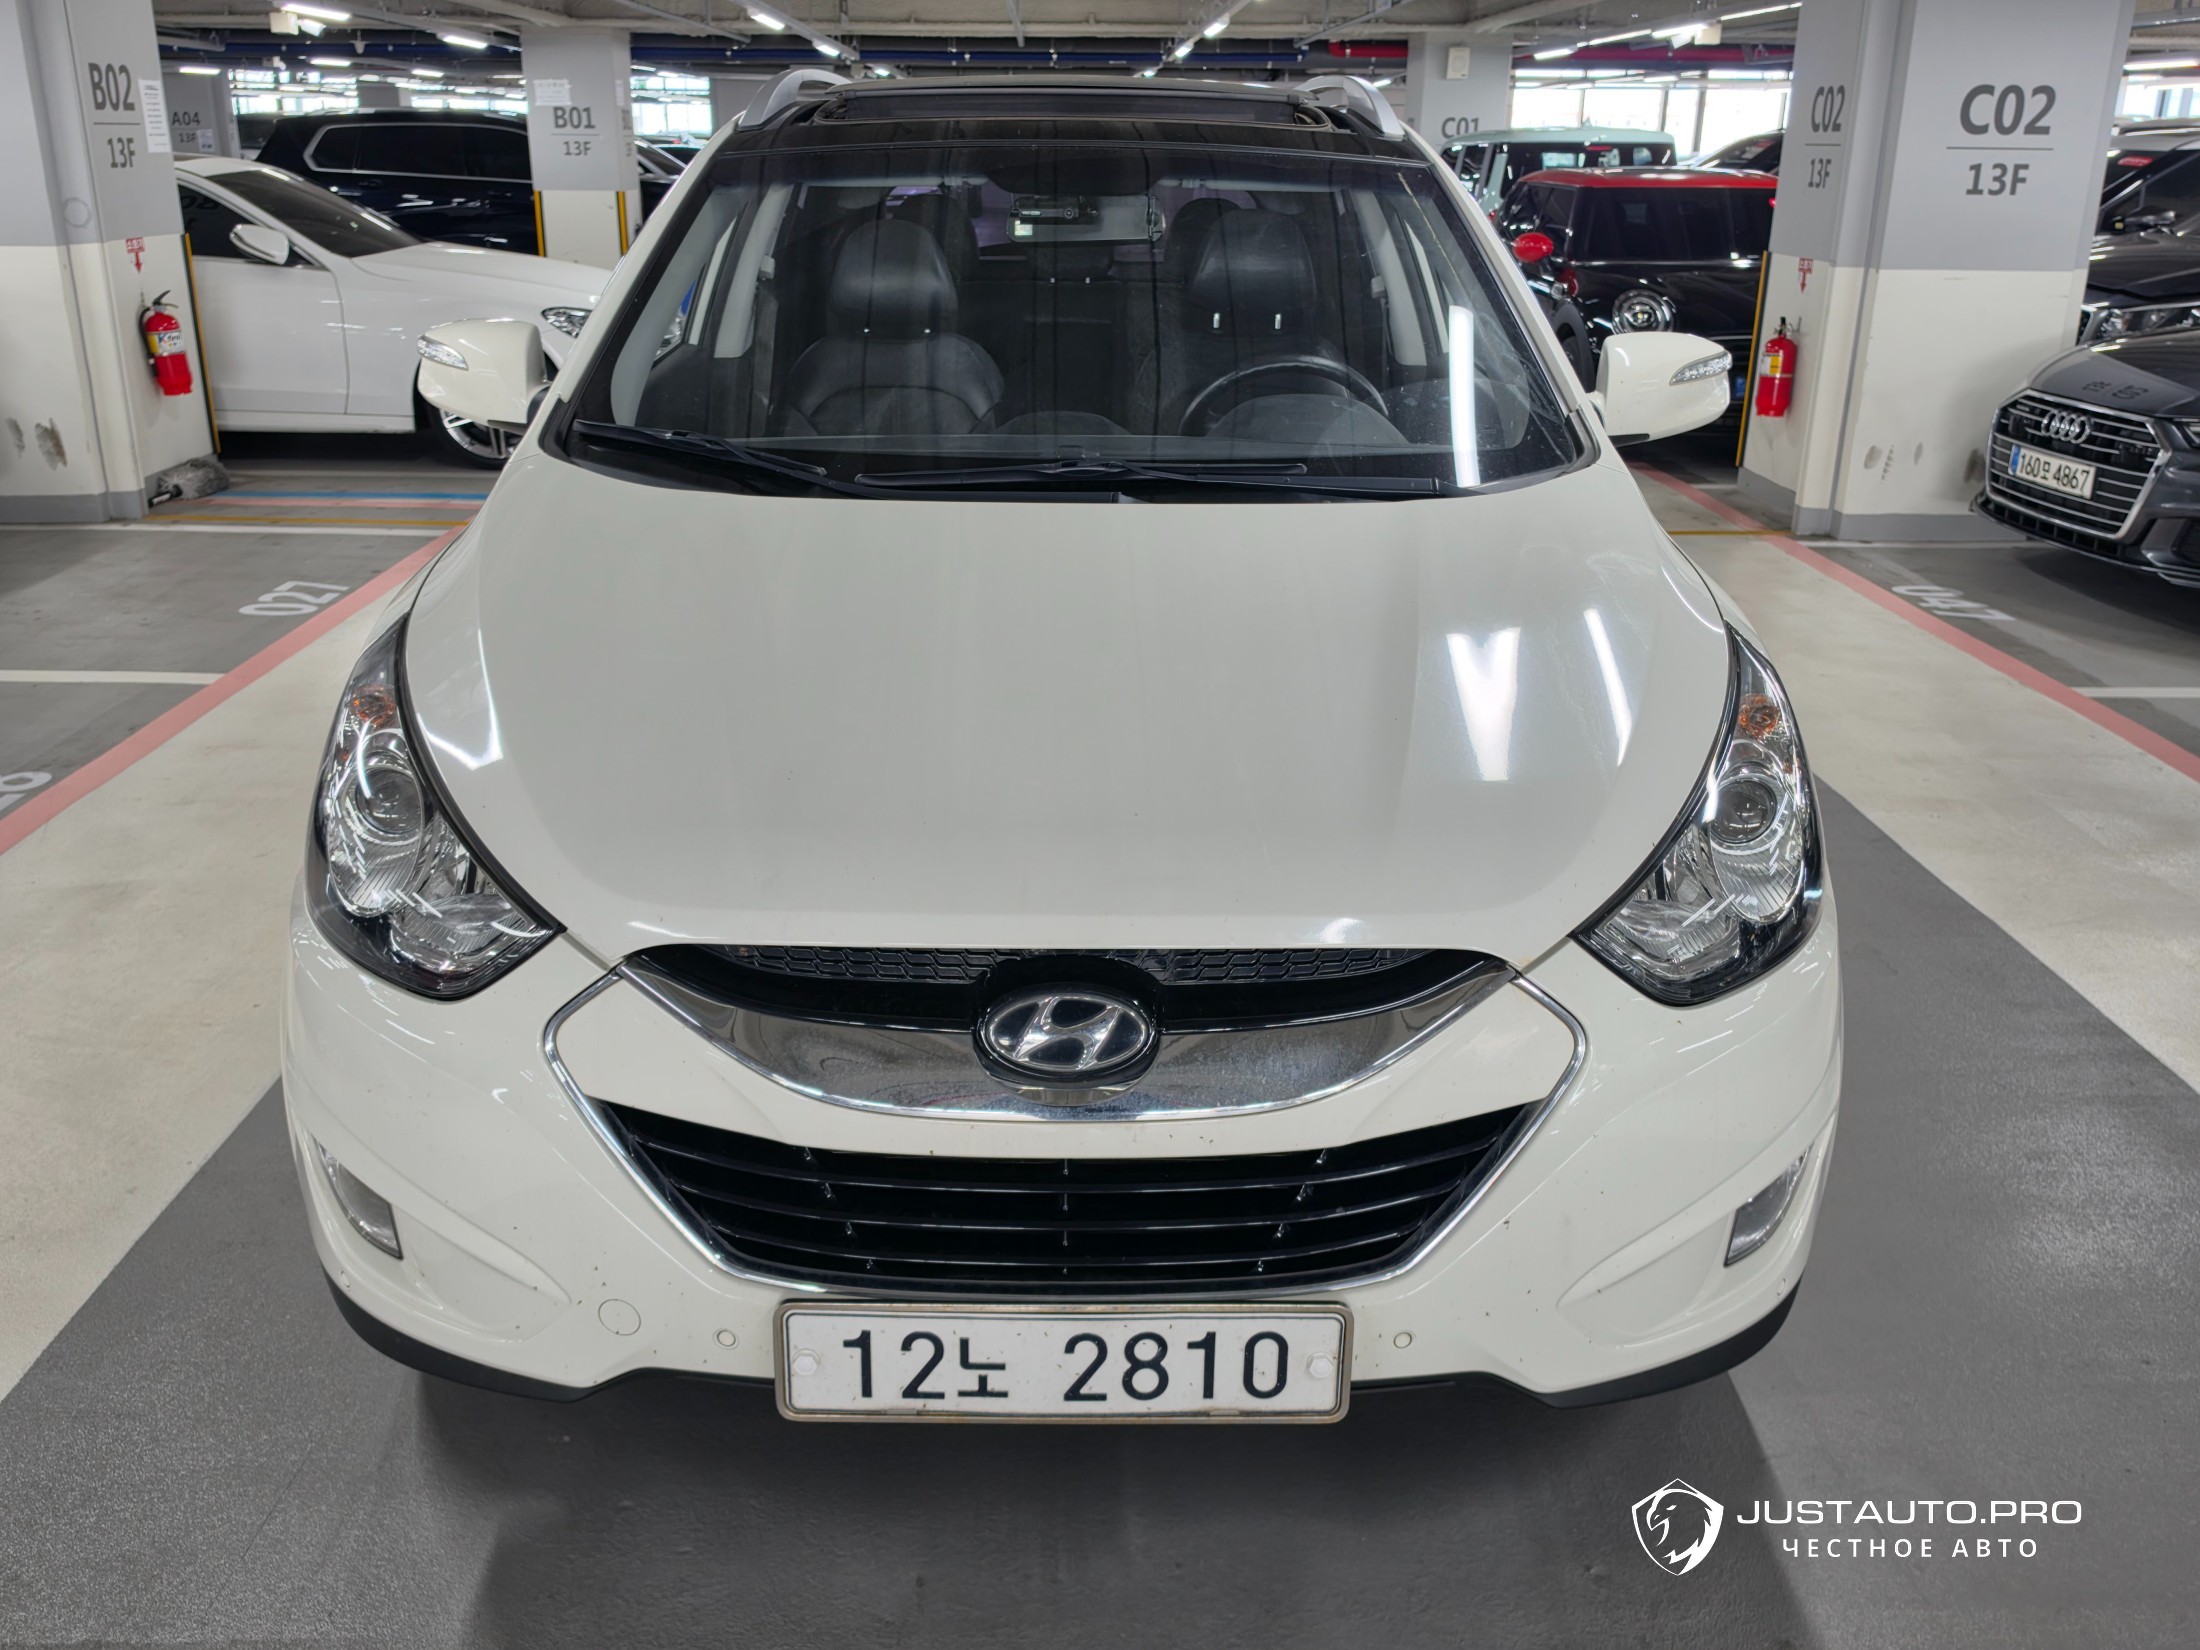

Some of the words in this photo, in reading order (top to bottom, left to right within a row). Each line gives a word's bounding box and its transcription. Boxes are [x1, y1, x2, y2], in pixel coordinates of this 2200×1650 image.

[88, 62, 136, 112] B02
[171, 111, 201, 126] A04
[553, 106, 596, 129] B01
[1811, 85, 1846, 133] C02
[1959, 84, 2057, 136] C02
[106, 137, 136, 169] 13F
[563, 141, 592, 156] 13F
[1807, 158, 1832, 189] 13F
[1965, 163, 2030, 196] 13F
[2052, 463, 2090, 492] 4867
[238, 580, 350, 616] 027
[842, 1330, 1009, 1400] 12노
[1063, 1331, 1289, 1402] 2810
